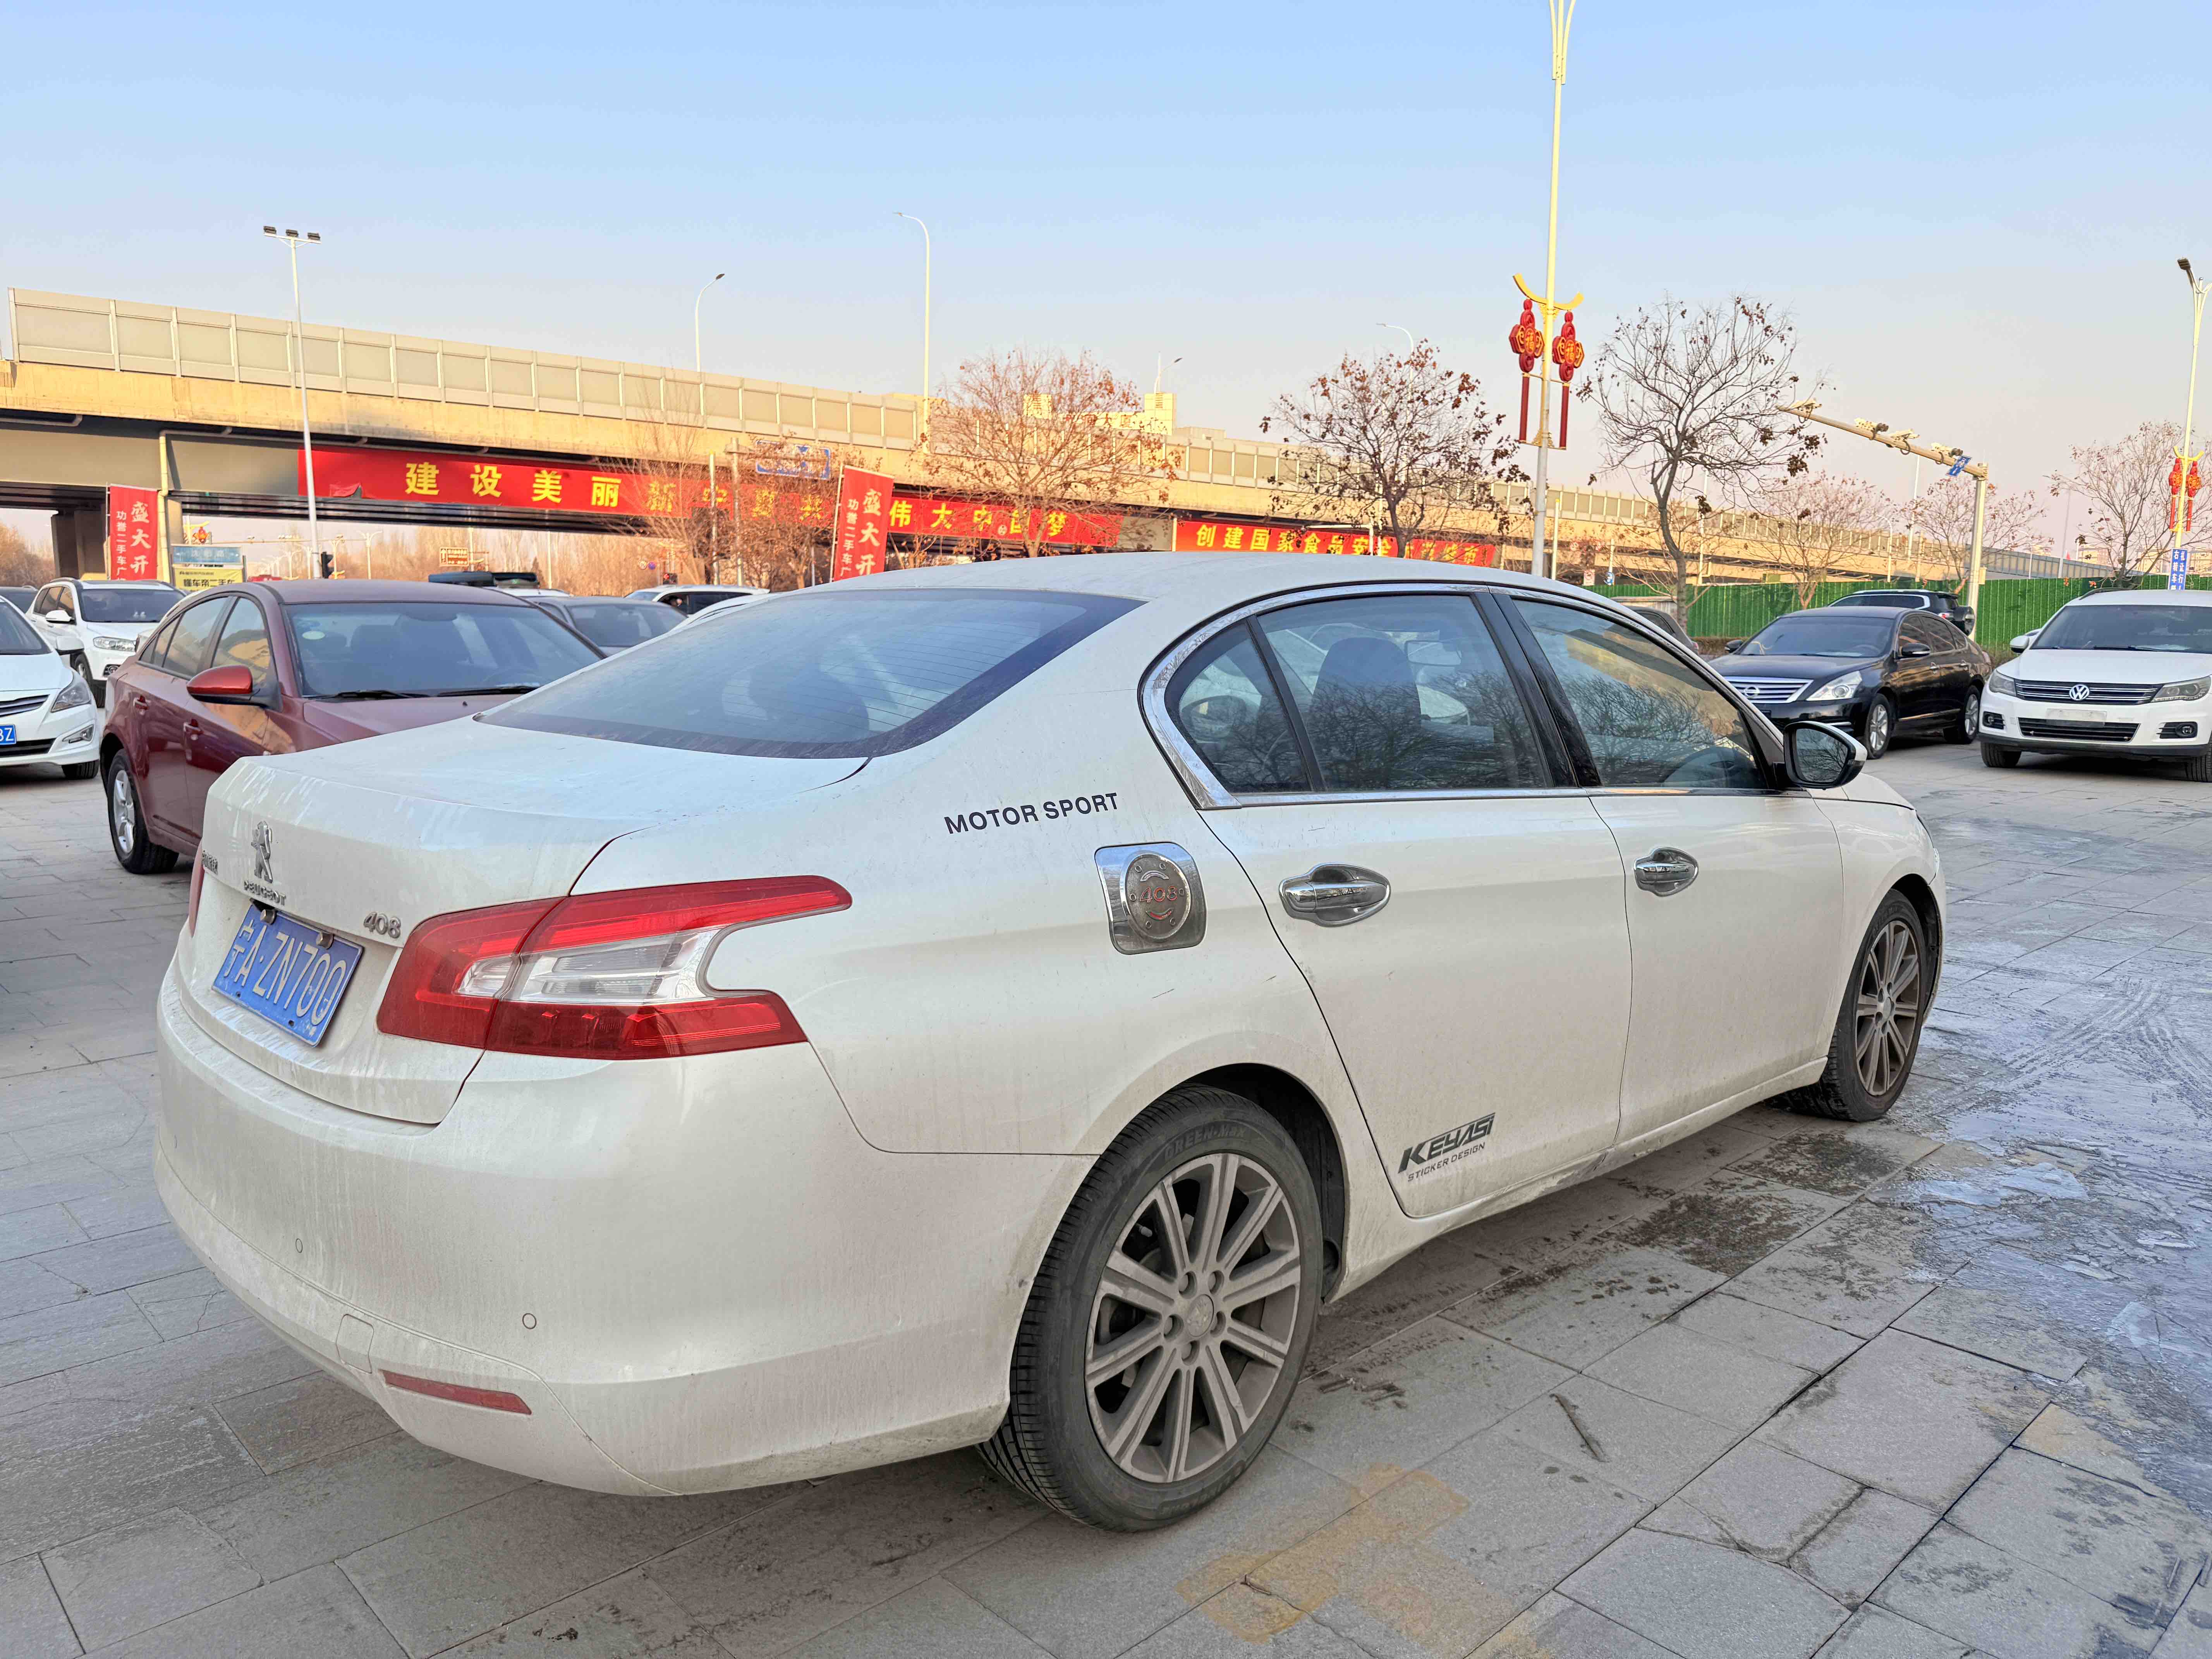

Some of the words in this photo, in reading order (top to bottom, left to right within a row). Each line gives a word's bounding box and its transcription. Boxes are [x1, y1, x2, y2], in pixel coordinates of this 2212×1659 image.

[116, 510, 127, 580] 功誉二手车广
[130, 501, 151, 575] 盛大开
[855, 488, 882, 575] 盛大开
[944, 804, 1039, 834] MOTOR
[1043, 792, 1118, 819] SPORT
[244, 879, 287, 906] PEUGEOT
[1139, 885, 1178, 904] 408
[363, 912, 402, 939] 408
[1408, 1158, 1449, 1182] STICKER
[1451, 1142, 1486, 1163] DESIGN
